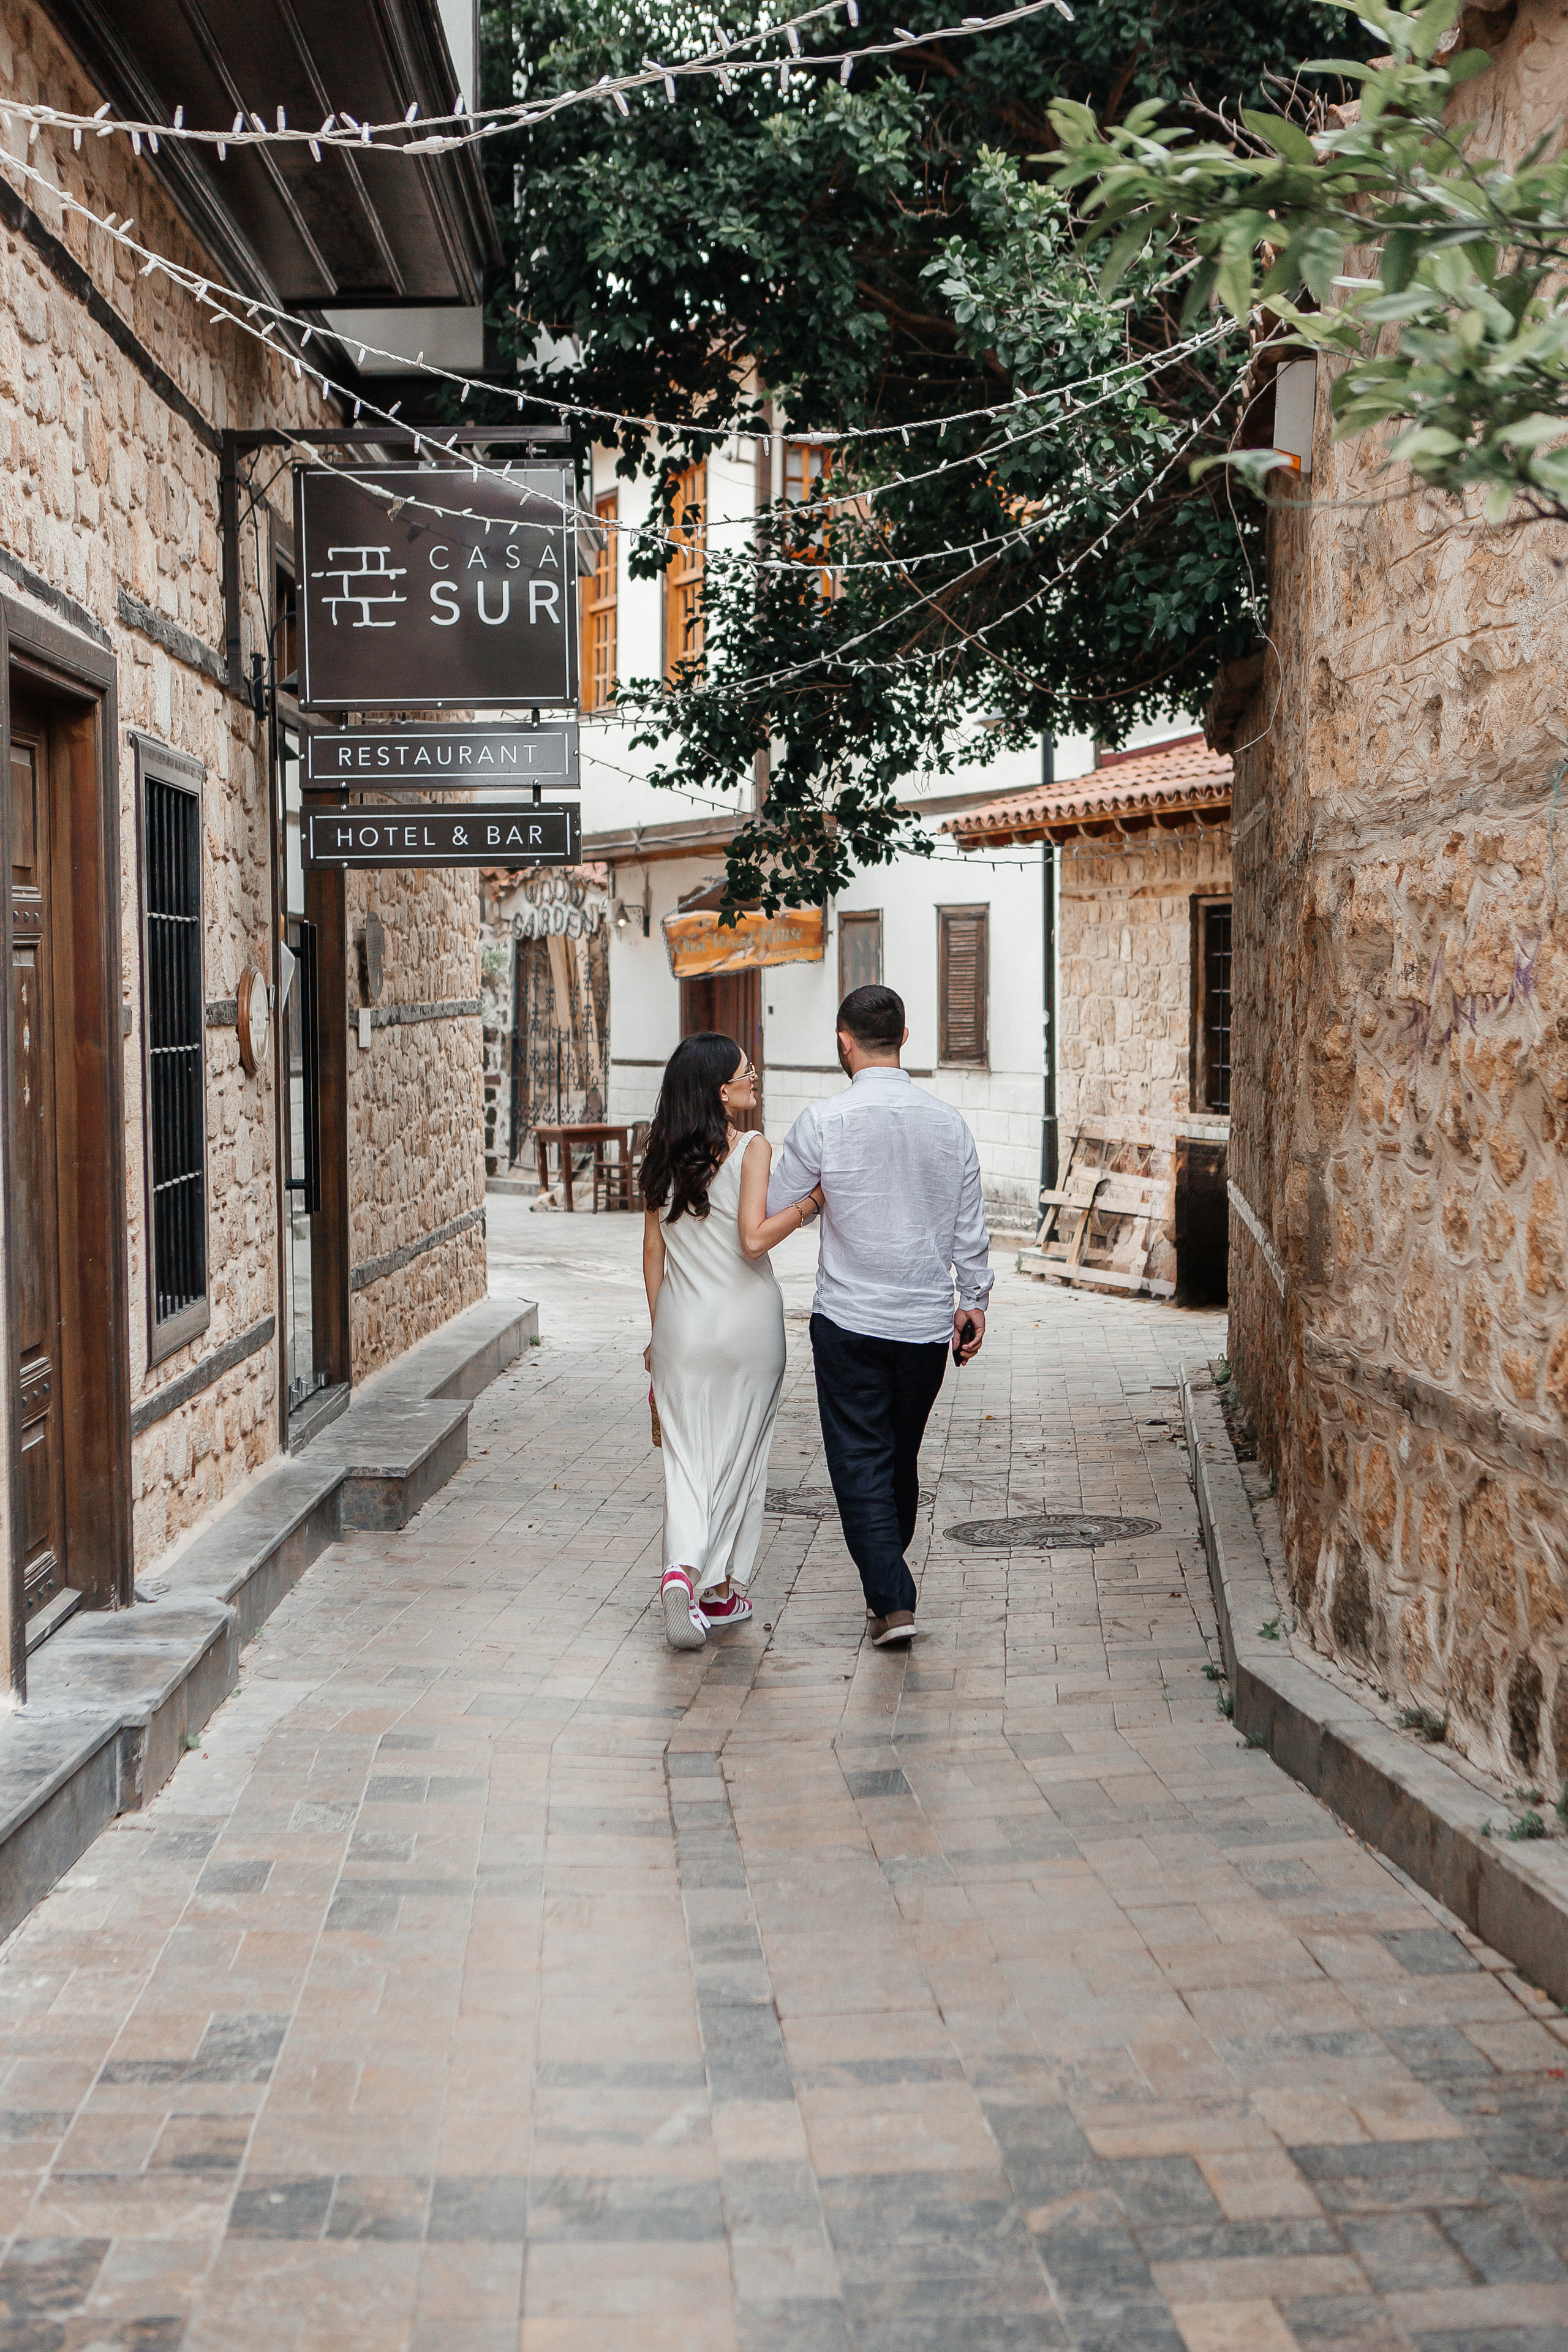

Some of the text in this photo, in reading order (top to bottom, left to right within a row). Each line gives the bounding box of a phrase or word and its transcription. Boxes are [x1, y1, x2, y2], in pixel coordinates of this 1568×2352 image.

[429, 545, 559, 570] CASA
[429, 579, 560, 625] SUR
[338, 744, 538, 767] RESTAURANT
[337, 825, 543, 848] HOTEL & BAR
[525, 876, 582, 908] WOOD
[512, 902, 598, 940] GARDEN
[674, 932, 709, 954] Old
[757, 922, 802, 946] House
